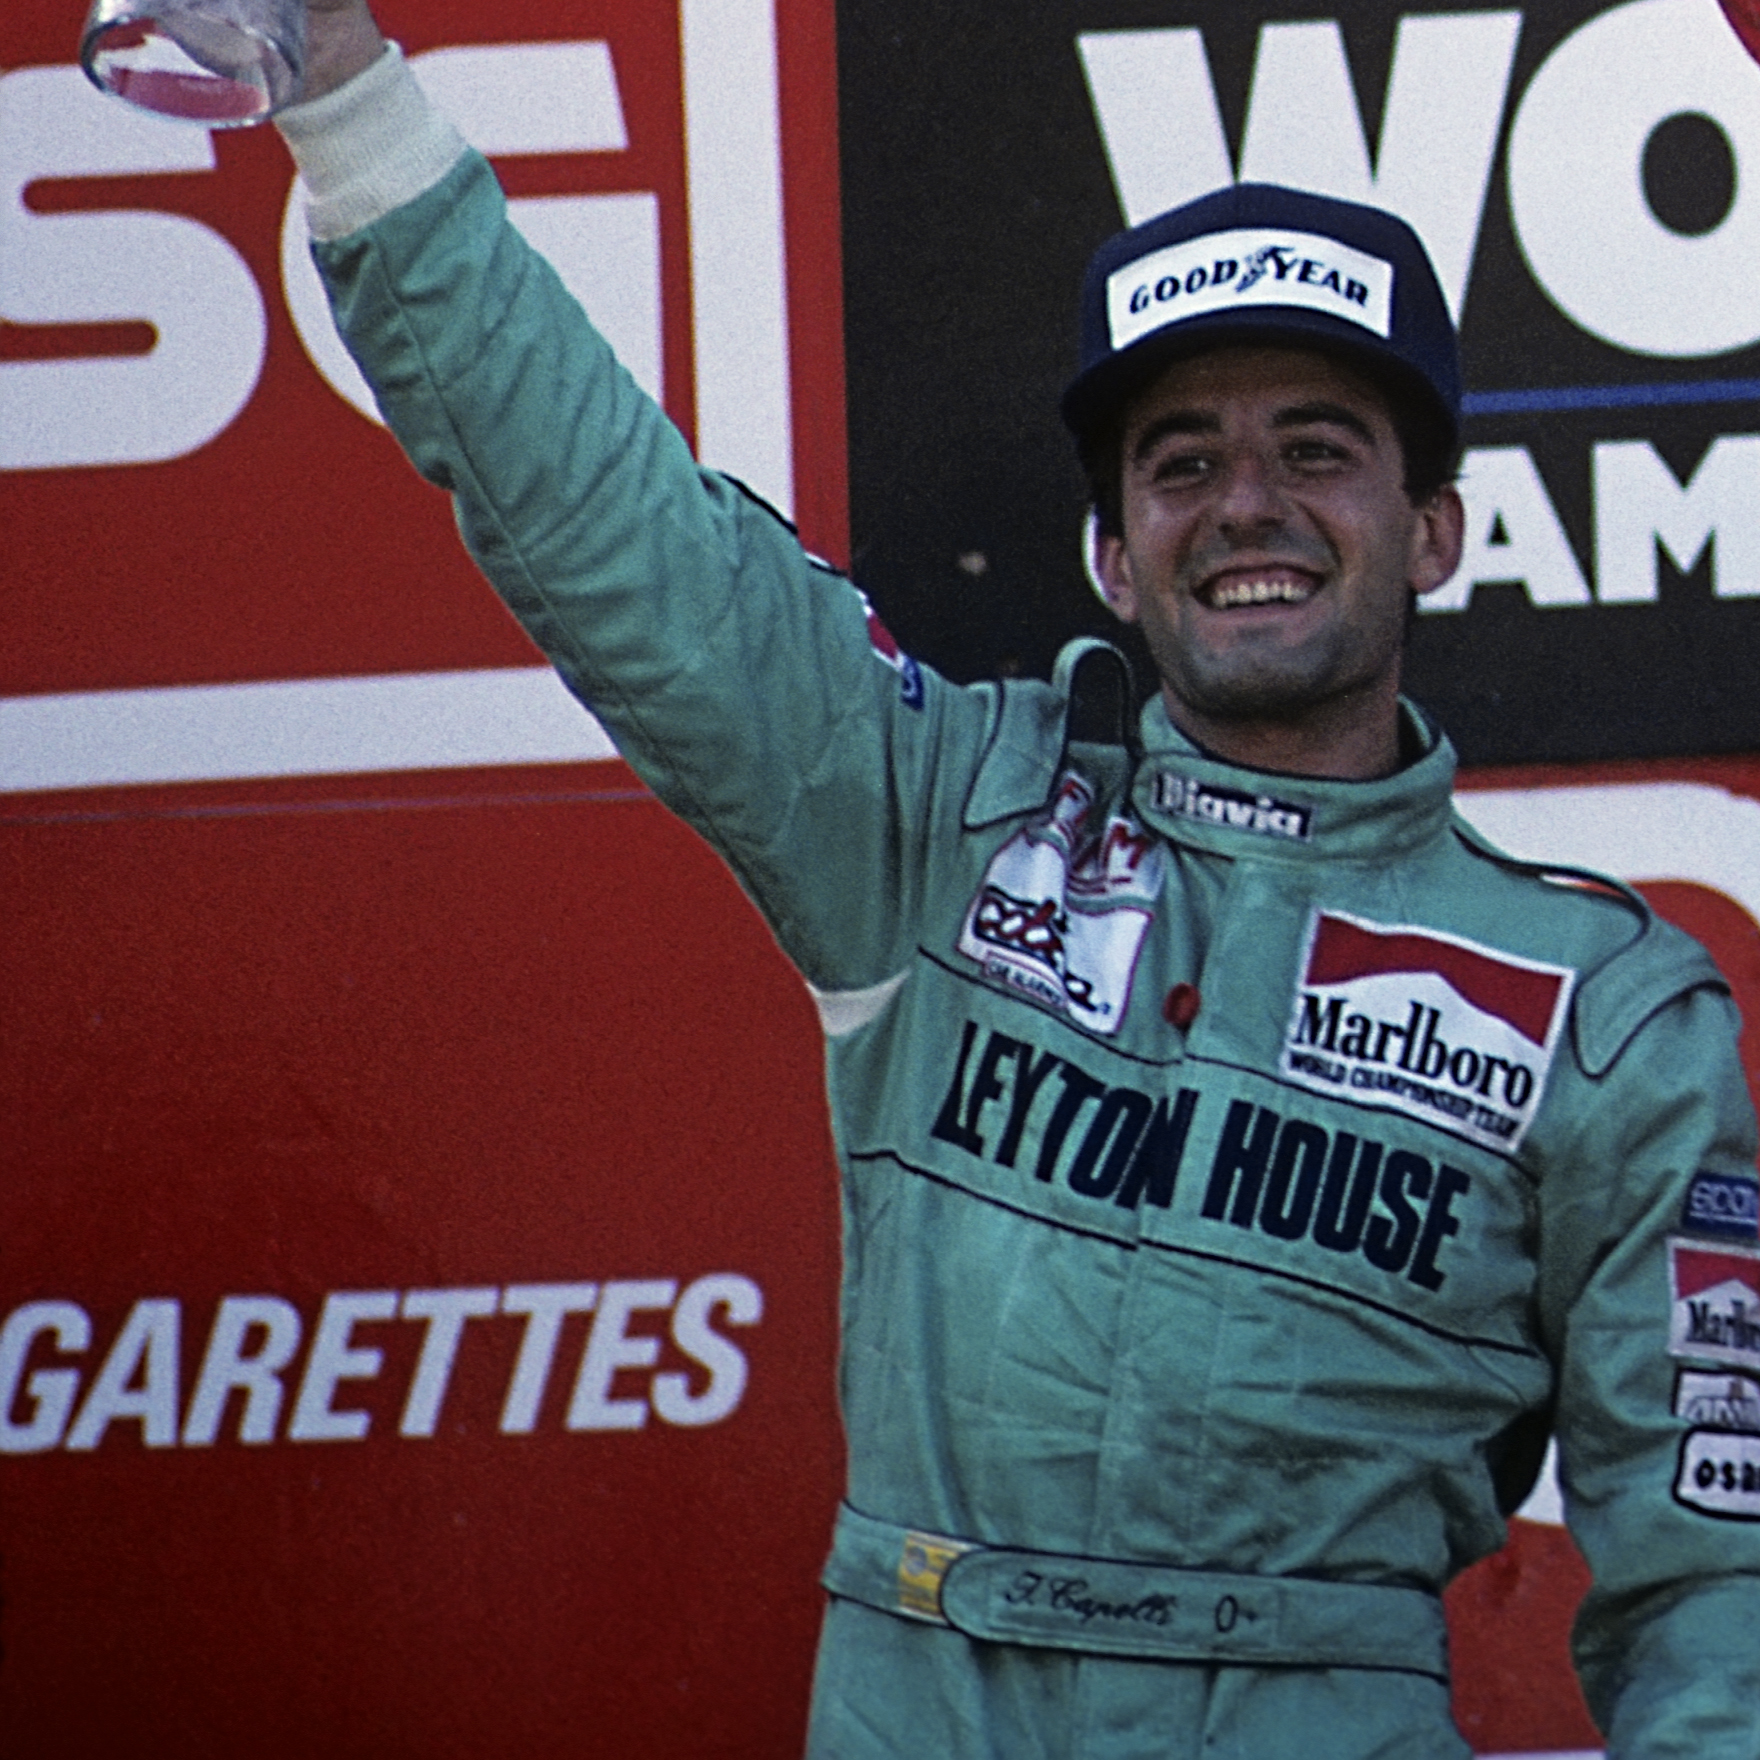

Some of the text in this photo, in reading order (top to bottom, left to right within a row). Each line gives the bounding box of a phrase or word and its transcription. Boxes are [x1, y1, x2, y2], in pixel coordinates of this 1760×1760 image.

[1129, 250, 1370, 318] GOOD YEAR
[1295, 992, 1534, 1109] Marlboro
[931, 1019, 1471, 1294] LEYTON HOUSE
